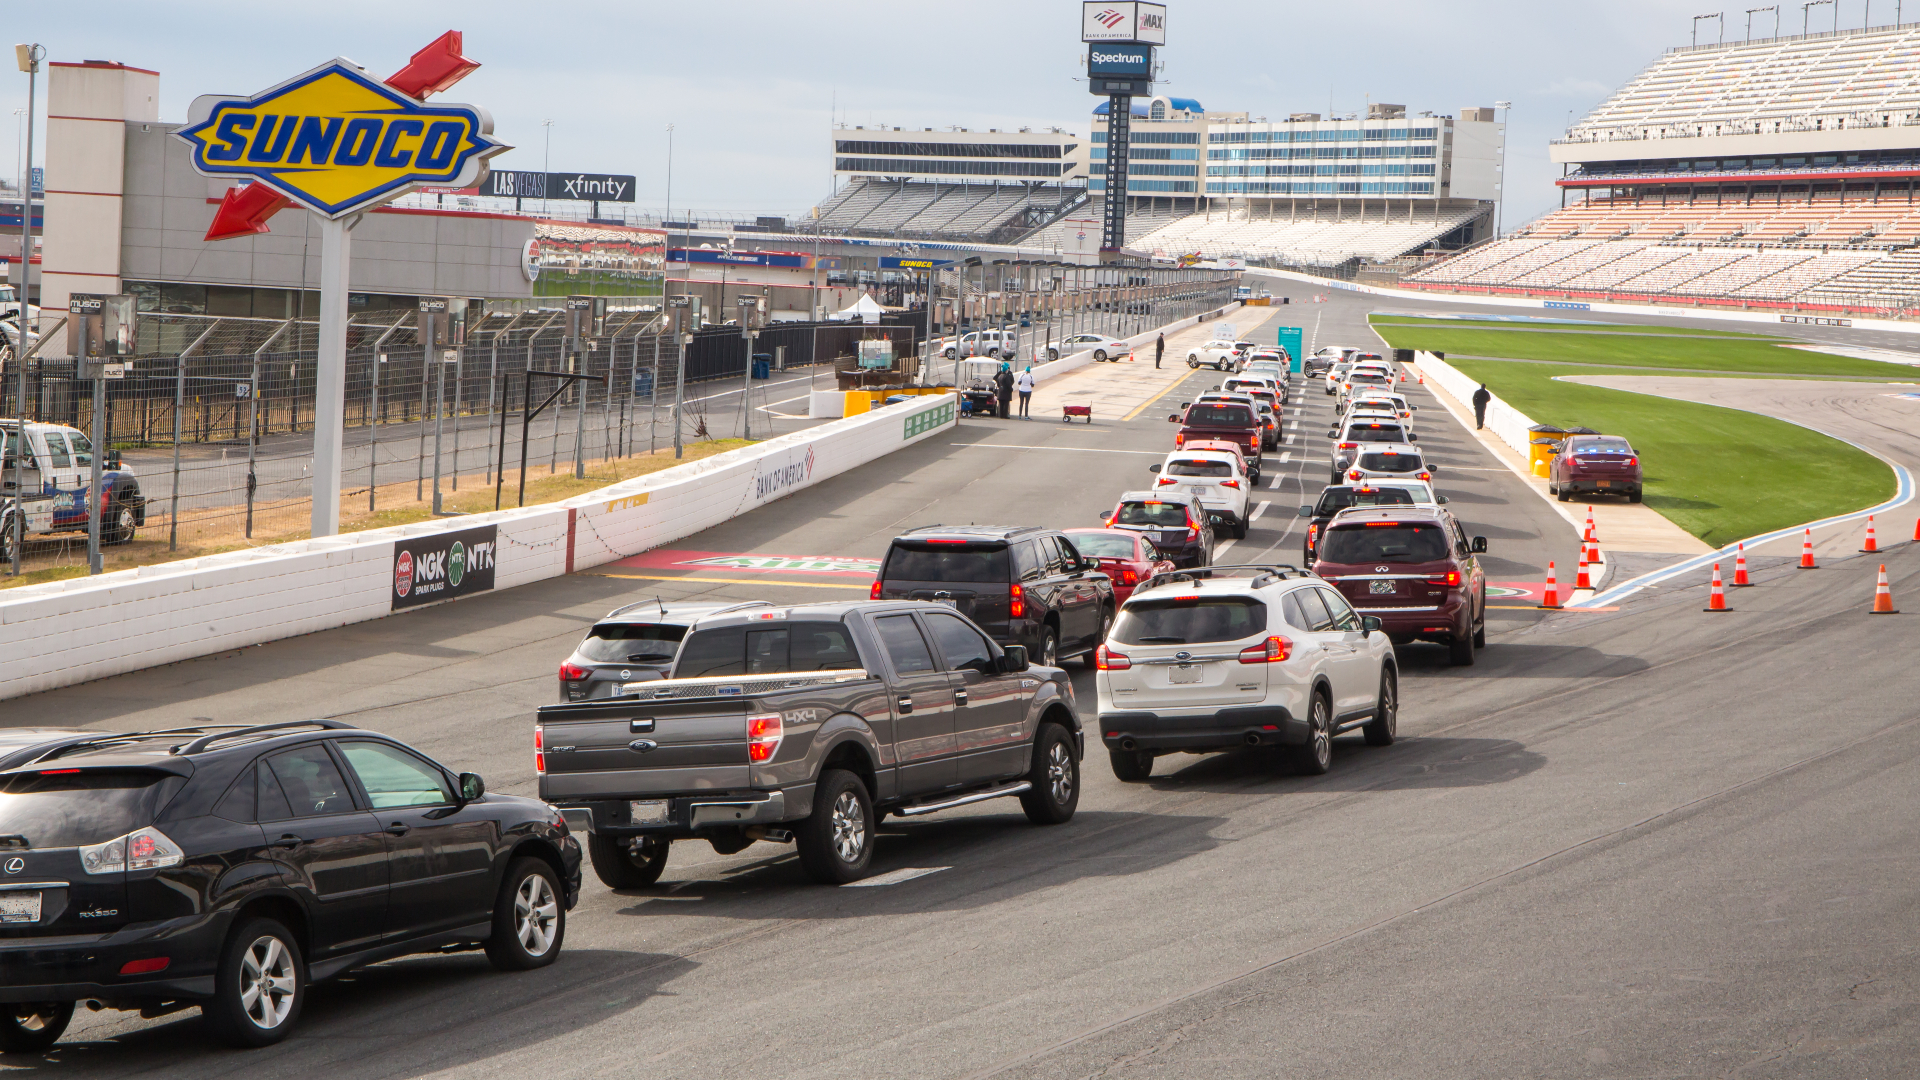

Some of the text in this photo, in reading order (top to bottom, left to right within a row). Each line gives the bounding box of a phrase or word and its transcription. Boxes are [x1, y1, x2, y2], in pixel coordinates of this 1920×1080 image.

[1092, 51, 1143, 64] Spectrum
[206, 113, 466, 169] SUNOCO
[563, 175, 627, 200] xfinity
[899, 260, 933, 268] SUNOCO
[757, 462, 804, 500] BANK OF AMERICA
[452, 552, 462, 564] NTK
[466, 540, 496, 572] NTK
[398, 562, 410, 573] NGK
[416, 550, 446, 583] NGK
[415, 582, 444, 595] SPARK PLUGS
